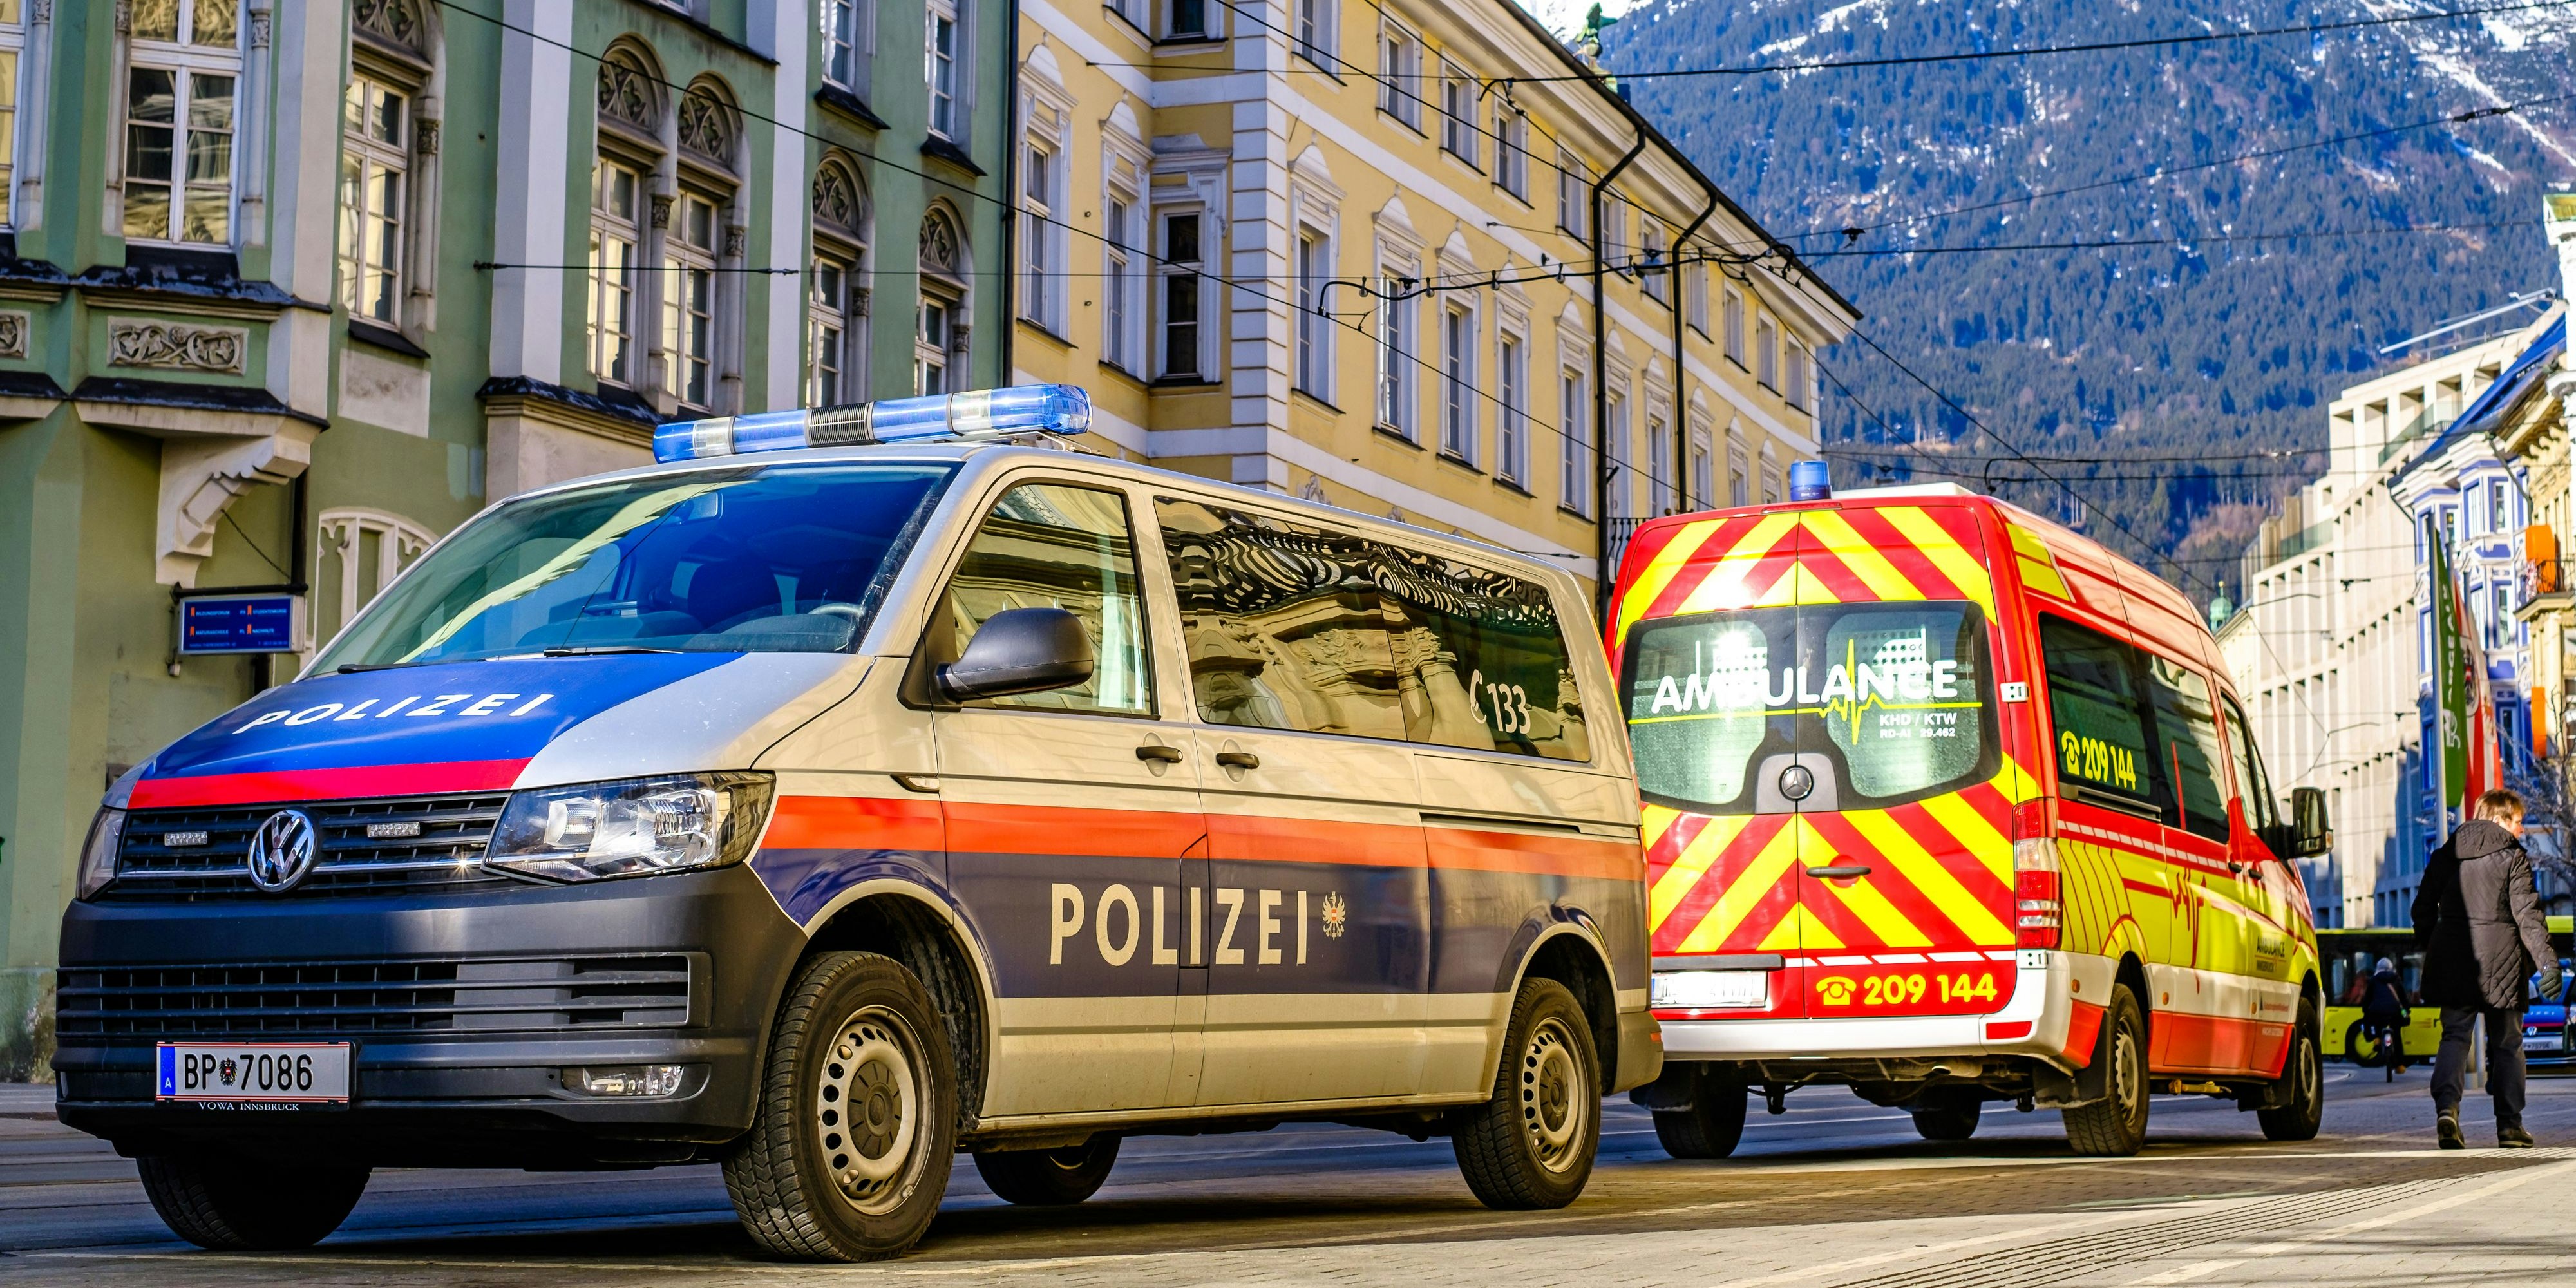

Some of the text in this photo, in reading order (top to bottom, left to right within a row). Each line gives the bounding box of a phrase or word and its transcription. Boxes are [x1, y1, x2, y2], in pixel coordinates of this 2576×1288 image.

[1651, 659, 1958, 714] AMBULANCE
[232, 694, 555, 735] POLIZEI
[1486, 683, 1531, 734] 133
[1880, 714, 1911, 726] KHD
[1924, 712, 1958, 725] KTW
[1920, 727, 1956, 737] 29.462
[2081, 737, 2136, 791] 209 144
[1050, 883, 1307, 966] POLIZEI
[1864, 972, 1998, 1005] 209 144
[165, 1077, 172, 1088] A
[184, 1054, 314, 1091] BP 7086
[198, 1101, 300, 1112] VOWA INNSBRUCK
